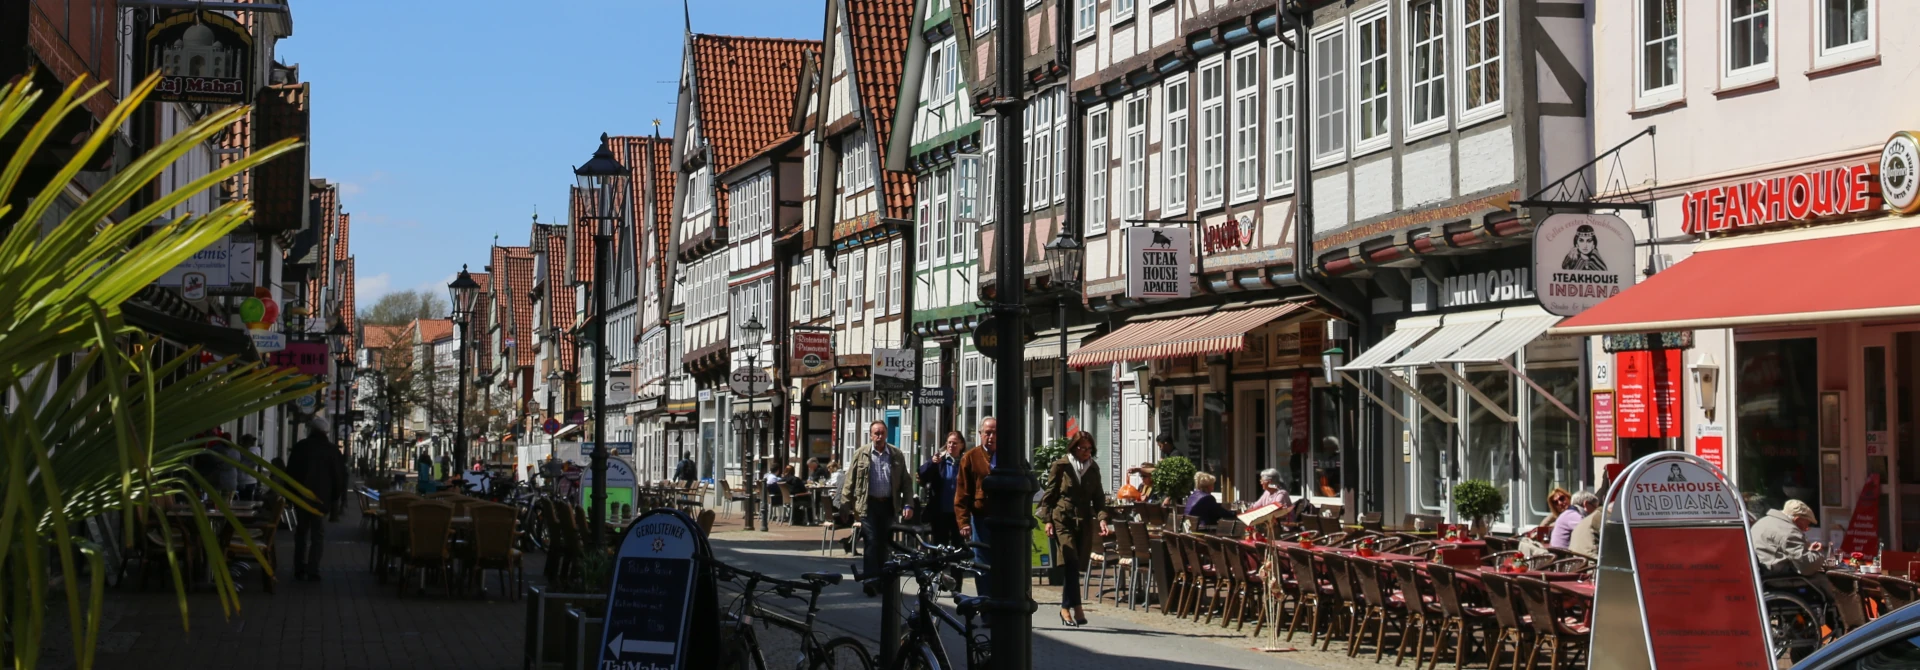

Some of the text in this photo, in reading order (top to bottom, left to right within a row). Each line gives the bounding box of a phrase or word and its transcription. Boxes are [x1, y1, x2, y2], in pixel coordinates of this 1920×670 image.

[185, 78, 244, 94] Mahal
[1680, 163, 1871, 235] STEAKHOUSE
[1203, 220, 1240, 252] APACHE
[1142, 252, 1178, 266] STEAK
[1143, 267, 1178, 280] HOUSE
[1553, 273, 1618, 284] STEAKHOUSE
[1143, 281, 1178, 293] APACHE
[1444, 267, 1535, 307] IMMOBIL
[1549, 283, 1620, 298] INDIANA
[256, 340, 280, 348] EZIA
[885, 357, 912, 369] Heta
[1597, 365, 1606, 379] 29
[920, 388, 943, 397] Salon
[608, 461, 627, 476] EMIS
[1636, 481, 1722, 493] STEAKHOUSE
[1634, 494, 1729, 511] INDIANA
[636, 523, 686, 539] GEROLSTEINER
